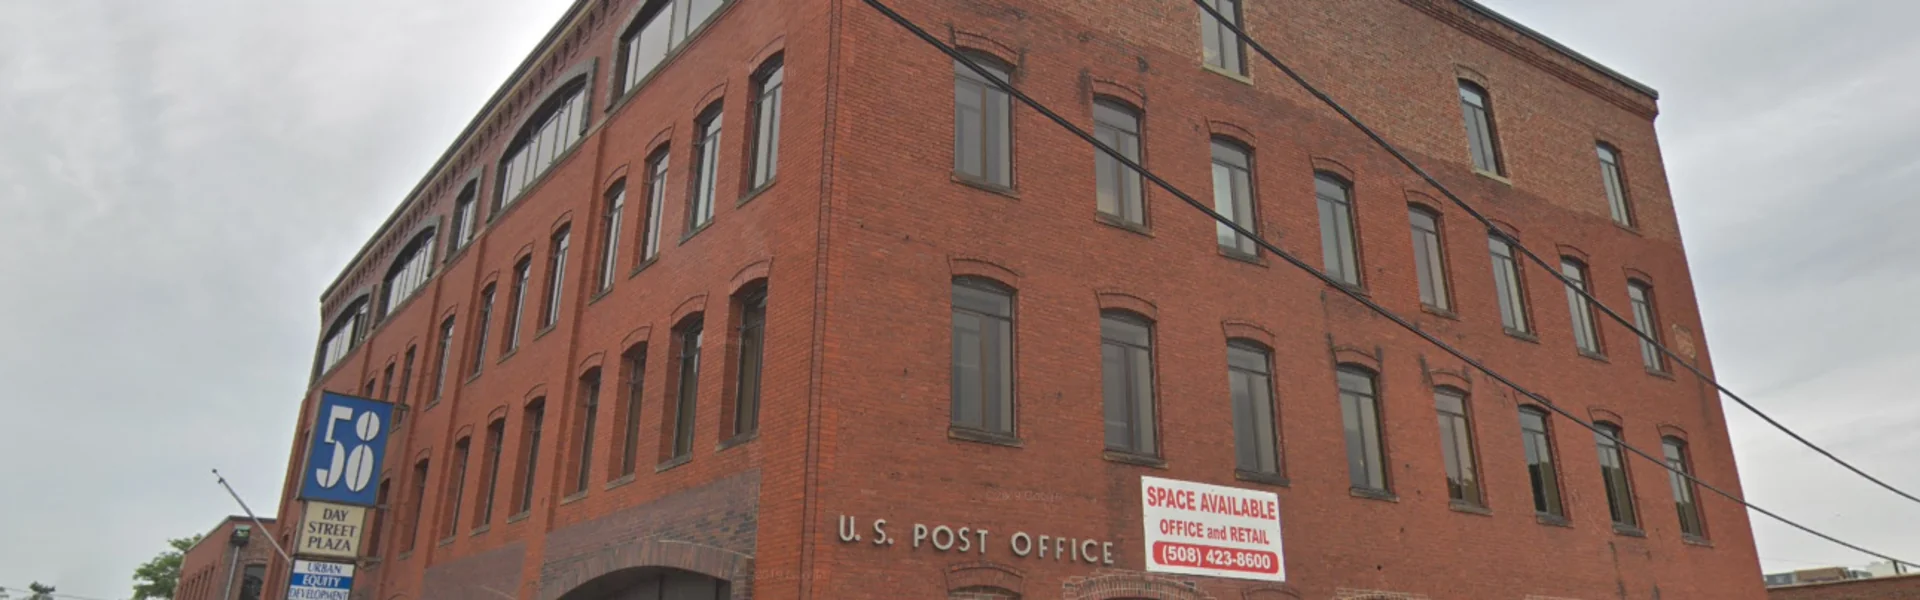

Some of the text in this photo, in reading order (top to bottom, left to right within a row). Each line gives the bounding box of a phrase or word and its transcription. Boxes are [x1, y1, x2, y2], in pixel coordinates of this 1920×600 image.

[316, 404, 380, 492] 58
[1147, 486, 1276, 520] SPACE AVAILABLE
[323, 508, 348, 521] DAY
[308, 521, 357, 537] STREET
[1160, 519, 1270, 545] OFFICE and RETAIL
[308, 536, 350, 551] PLAZA
[912, 523, 988, 554] POST
[1010, 531, 1114, 564] OFFICE
[1162, 545, 1271, 569] (508) 423-8600
[307, 562, 341, 573] URBAN
[302, 574, 341, 588] EQUITY
[288, 587, 348, 600] DEVELOPMENT
